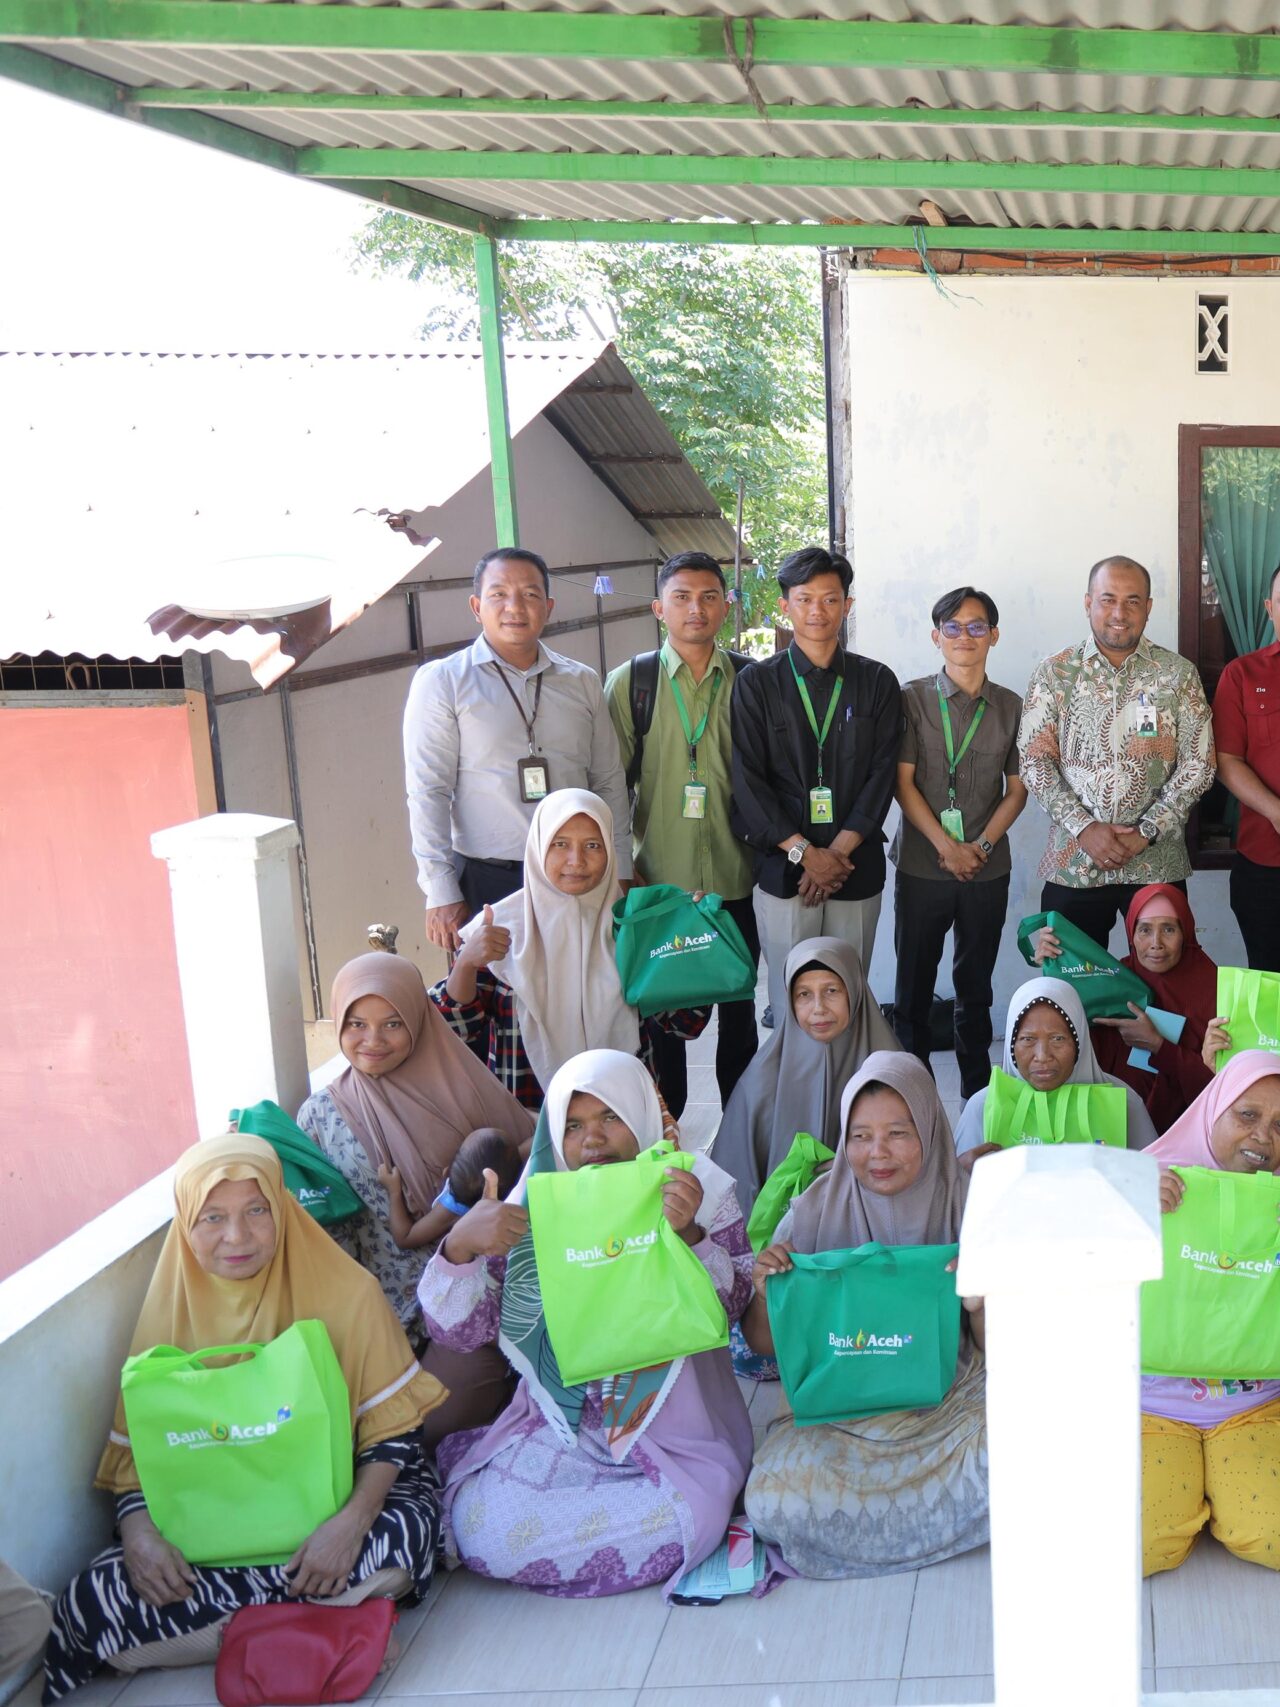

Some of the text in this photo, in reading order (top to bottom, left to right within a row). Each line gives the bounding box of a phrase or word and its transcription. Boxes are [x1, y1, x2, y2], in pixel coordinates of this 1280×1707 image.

[650, 932, 713, 959] Bank Aceh
[1061, 964, 1085, 974] Bank
[565, 1246, 605, 1263] Bank
[1180, 1244, 1218, 1265] Bank
[828, 1332, 903, 1348] Bank Aceh
[166, 1429, 212, 1446] Bank
[231, 1422, 277, 1439] Aceh
